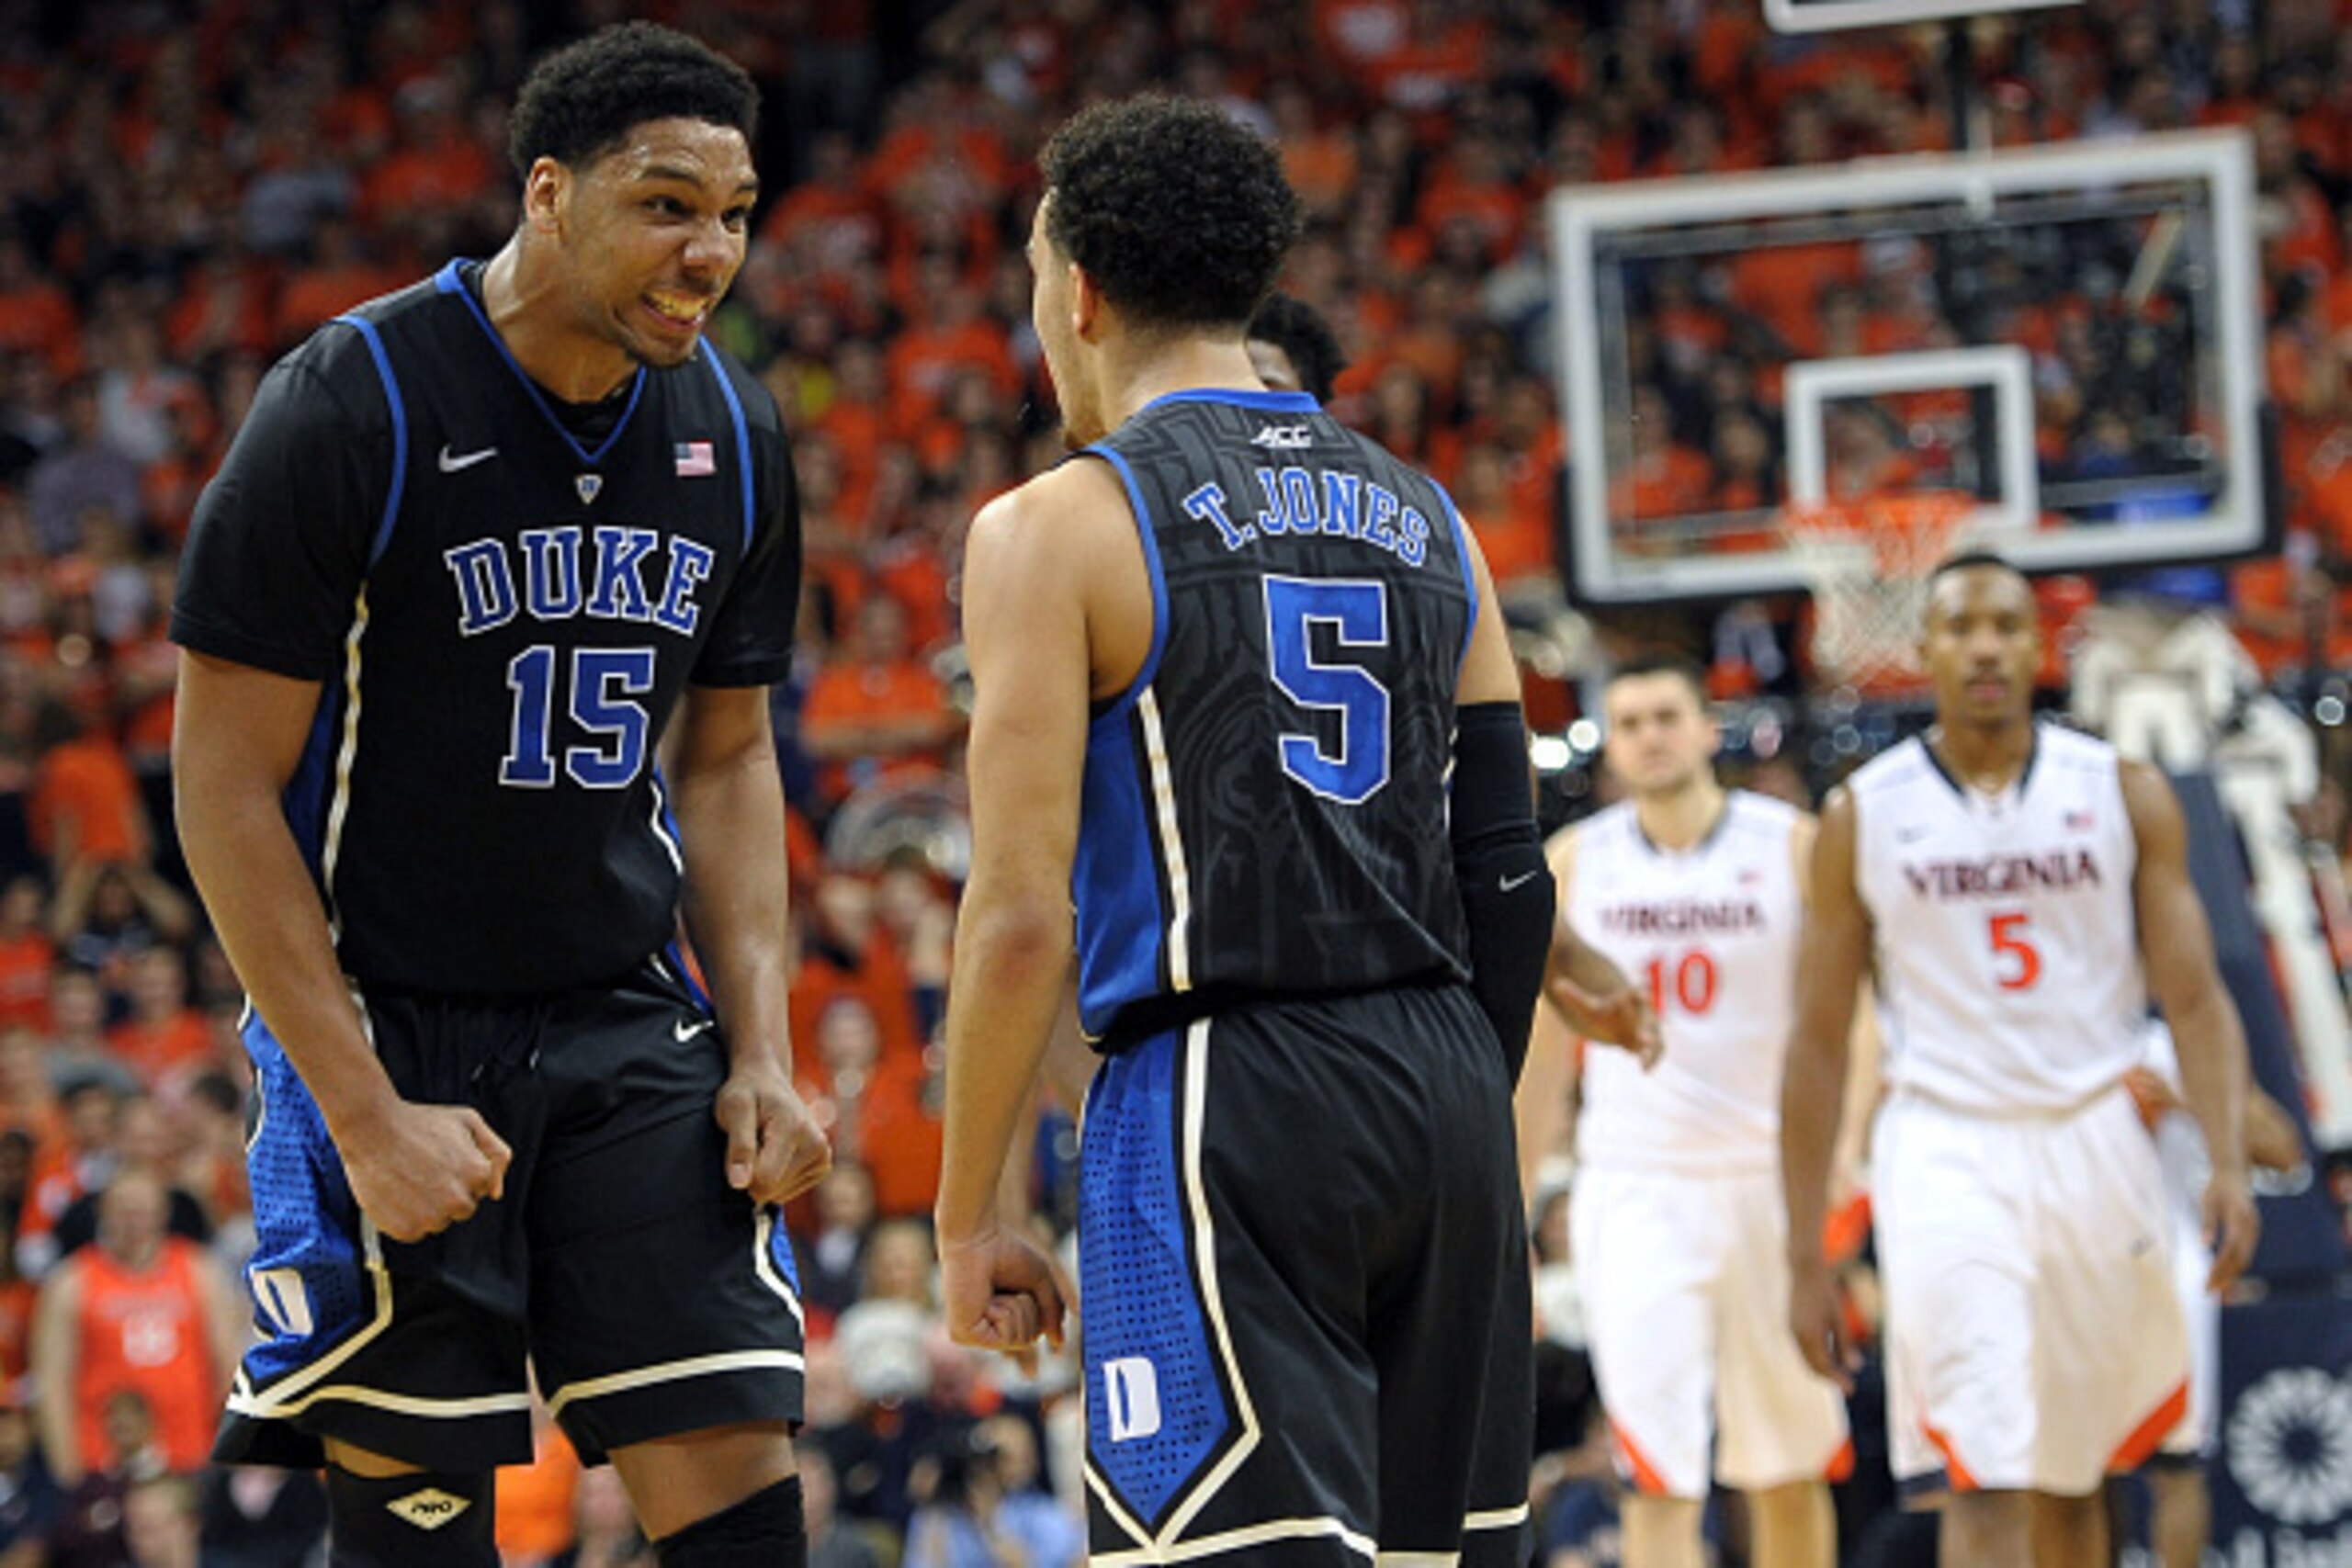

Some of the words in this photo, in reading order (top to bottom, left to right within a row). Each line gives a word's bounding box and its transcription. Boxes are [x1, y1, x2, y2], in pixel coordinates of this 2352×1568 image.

[1250, 423, 1312, 449] ACC
[1255, 467, 1430, 567] JONES
[443, 525, 715, 636] DUKE
[498, 645, 655, 789] 15
[1261, 574, 1390, 805] 5
[1904, 851, 2100, 900] VIRGINIA
[1645, 950, 1718, 1017] 10
[1987, 912, 2041, 992] 5
[1102, 1357, 1161, 1442] D
